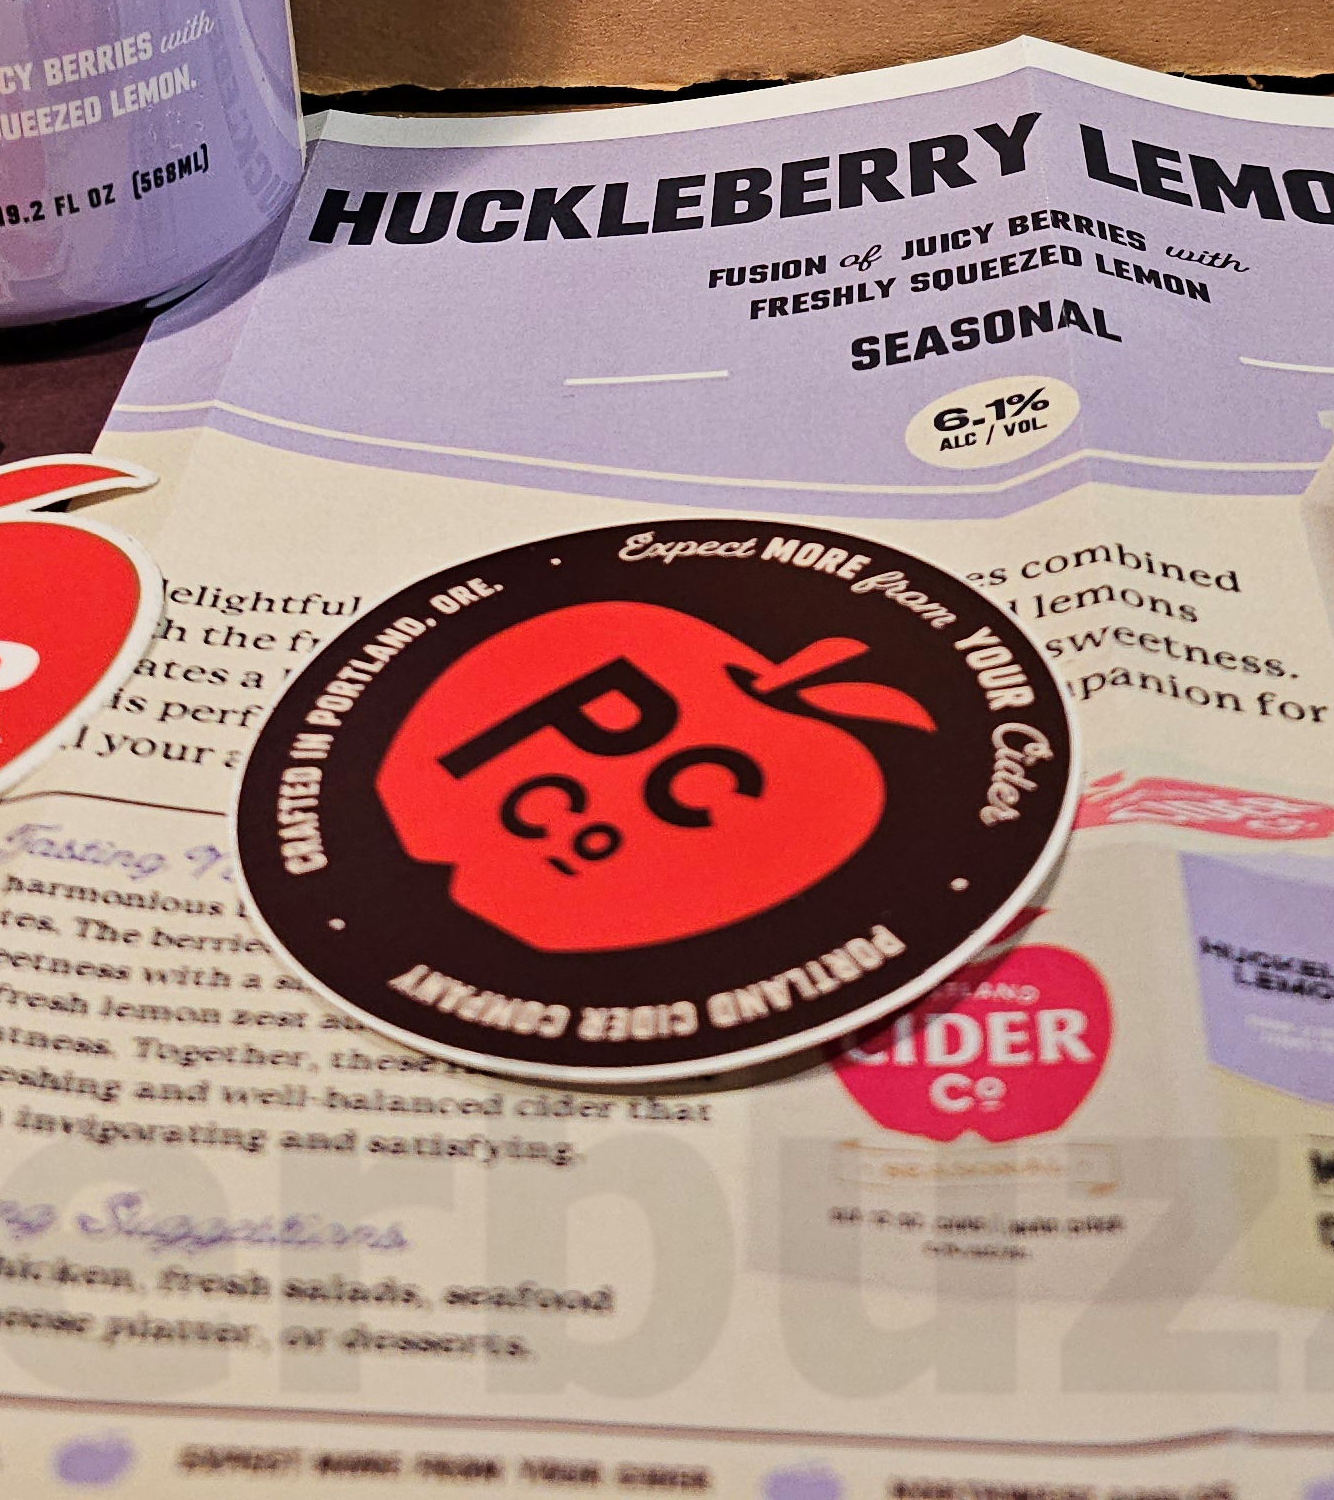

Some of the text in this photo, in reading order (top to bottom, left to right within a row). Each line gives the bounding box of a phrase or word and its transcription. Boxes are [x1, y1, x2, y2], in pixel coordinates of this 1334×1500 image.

[43, 31, 153, 87] BERRIES
[160, 10, 215, 55] with
[109, 63, 197, 118] LEMON.
[54, 194, 80, 217] FL
[87, 183, 115, 208] OZ
[308, 111, 1042, 246] HUCKLEBERRY
[708, 209, 1250, 288] FUSION of JUICY BERRIES with
[749, 243, 1211, 320] FRESHLY SQUEEZED LEMON
[851, 298, 1123, 371] SEASONAL
[933, 386, 1050, 432] 6.1%
[618, 531, 758, 564] Expect
[761, 537, 872, 581] MORE
[1020, 542, 1242, 593] combined
[203, 623, 276, 651] the
[1035, 582, 1198, 623] lemons
[429, 577, 504, 615] ORE.
[851, 571, 957, 629] from
[134, 624, 1300, 689] ates a sweetness.
[953, 626, 1036, 712] YOUR
[157, 700, 263, 728] perf
[1067, 668, 1243, 712] panion
[1257, 693, 1329, 723] for
[96, 731, 215, 764] your
[289, 733, 335, 759] IN
[979, 722, 1055, 827] Cider
[277, 766, 328, 876] CRAFTED
[4, 873, 224, 917] harmonious
[74, 916, 142, 945] The
[150, 926, 271, 955] berrie
[141, 964, 232, 989] with
[241, 972, 262, 990] a
[386, 924, 906, 1041] PORTLAND CIDER COMPANY
[99, 996, 222, 1025] lemon
[229, 1007, 309, 1029] zest
[842, 1008, 1096, 1066] CIDER
[133, 1035, 321, 1075] Together,
[132, 1080, 210, 1105] and
[222, 1083, 504, 1118] well-balanced
[516, 1094, 612, 1120] cider
[628, 1097, 713, 1123] that
[15, 1103, 267, 1153] invigorating
[279, 1125, 356, 1151] and
[367, 1128, 582, 1168] satisfying.
